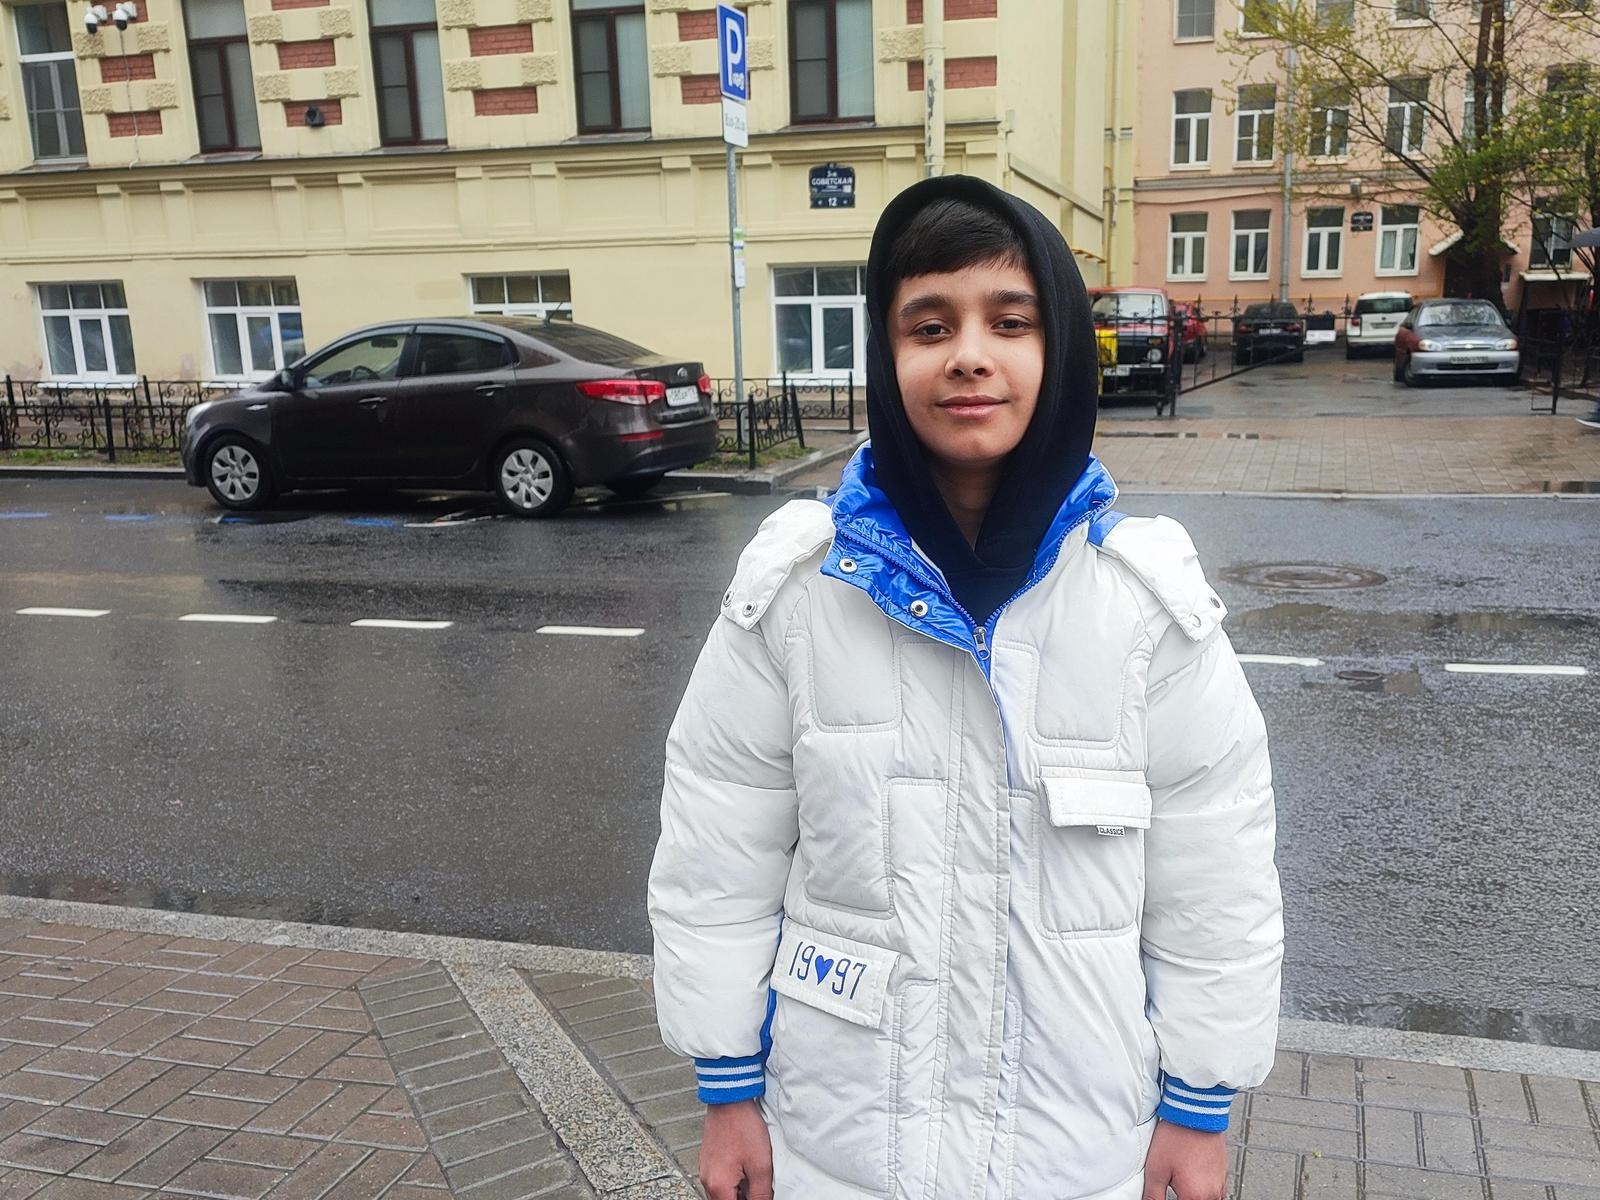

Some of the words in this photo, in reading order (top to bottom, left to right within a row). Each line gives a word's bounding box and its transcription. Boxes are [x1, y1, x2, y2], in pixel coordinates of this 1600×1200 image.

[725, 17, 743, 87] P
[811, 177, 853, 186] СОВЕТСКАЯ
[828, 197, 838, 207] 12
